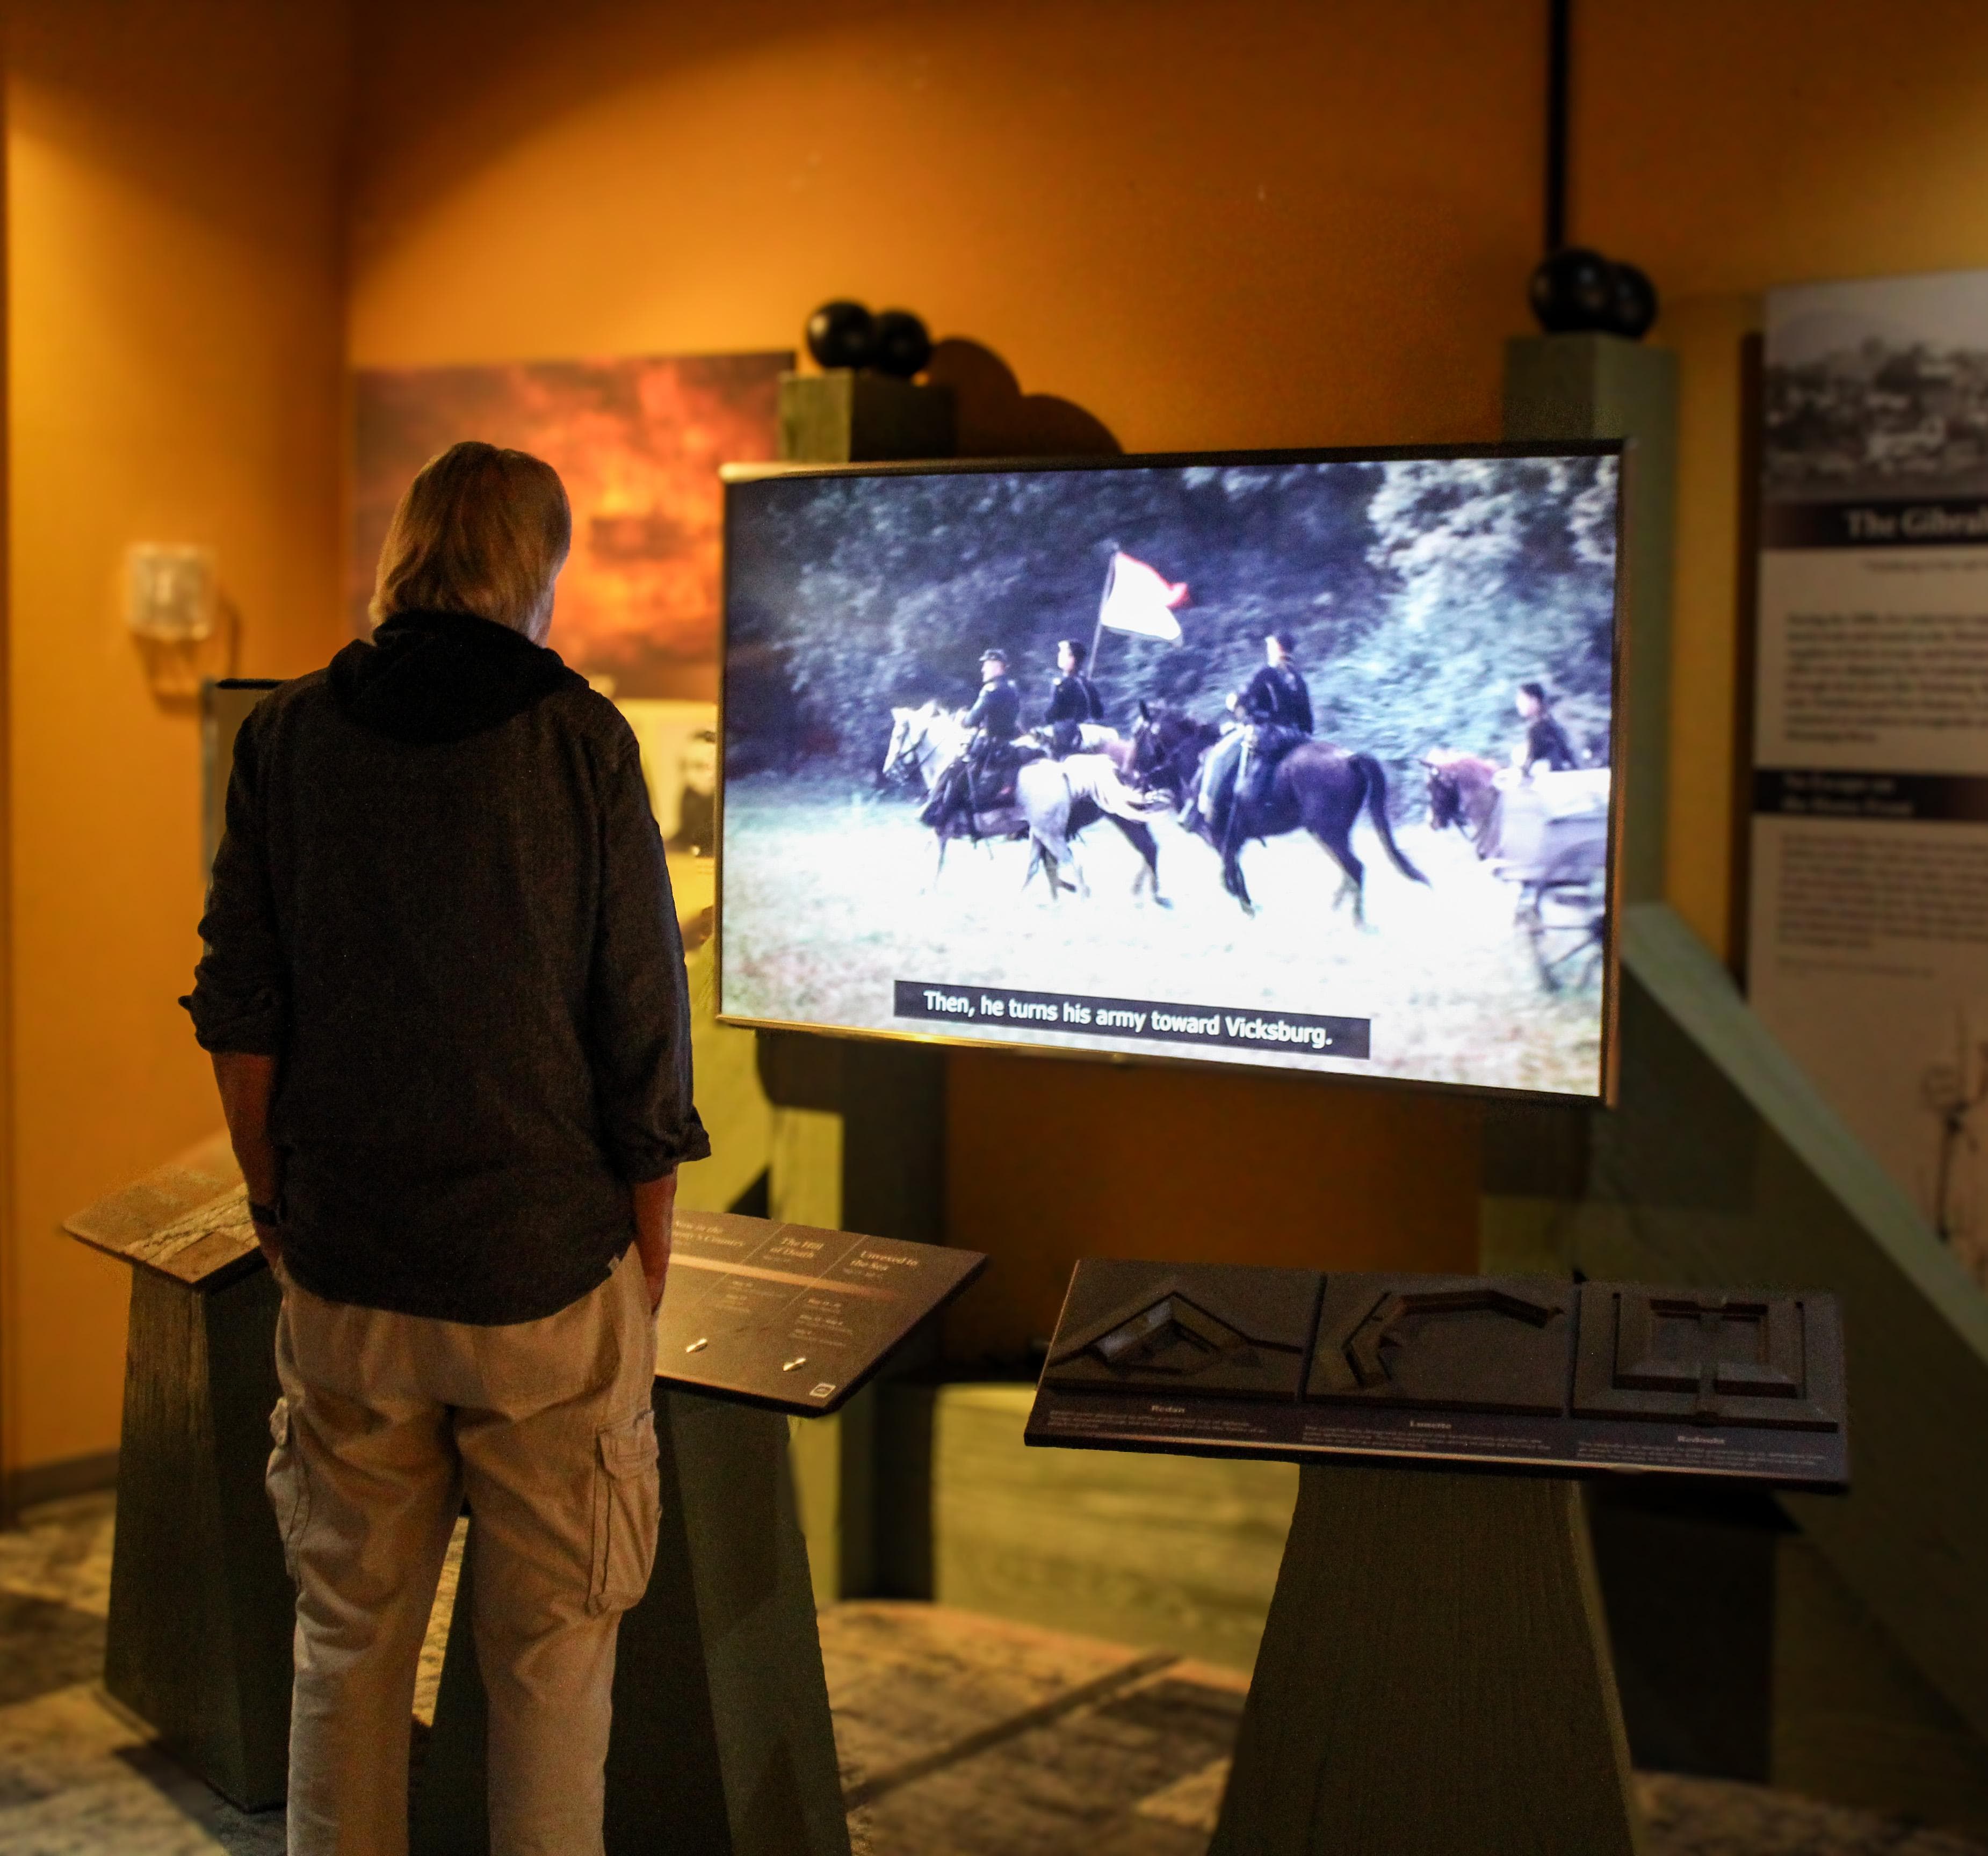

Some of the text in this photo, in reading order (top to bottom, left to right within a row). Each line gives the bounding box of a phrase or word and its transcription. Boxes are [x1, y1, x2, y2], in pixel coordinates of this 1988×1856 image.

[1845, 508, 1896, 539] The
[923, 990, 1333, 1049] Then, he turns his army toward Vicksburg.
